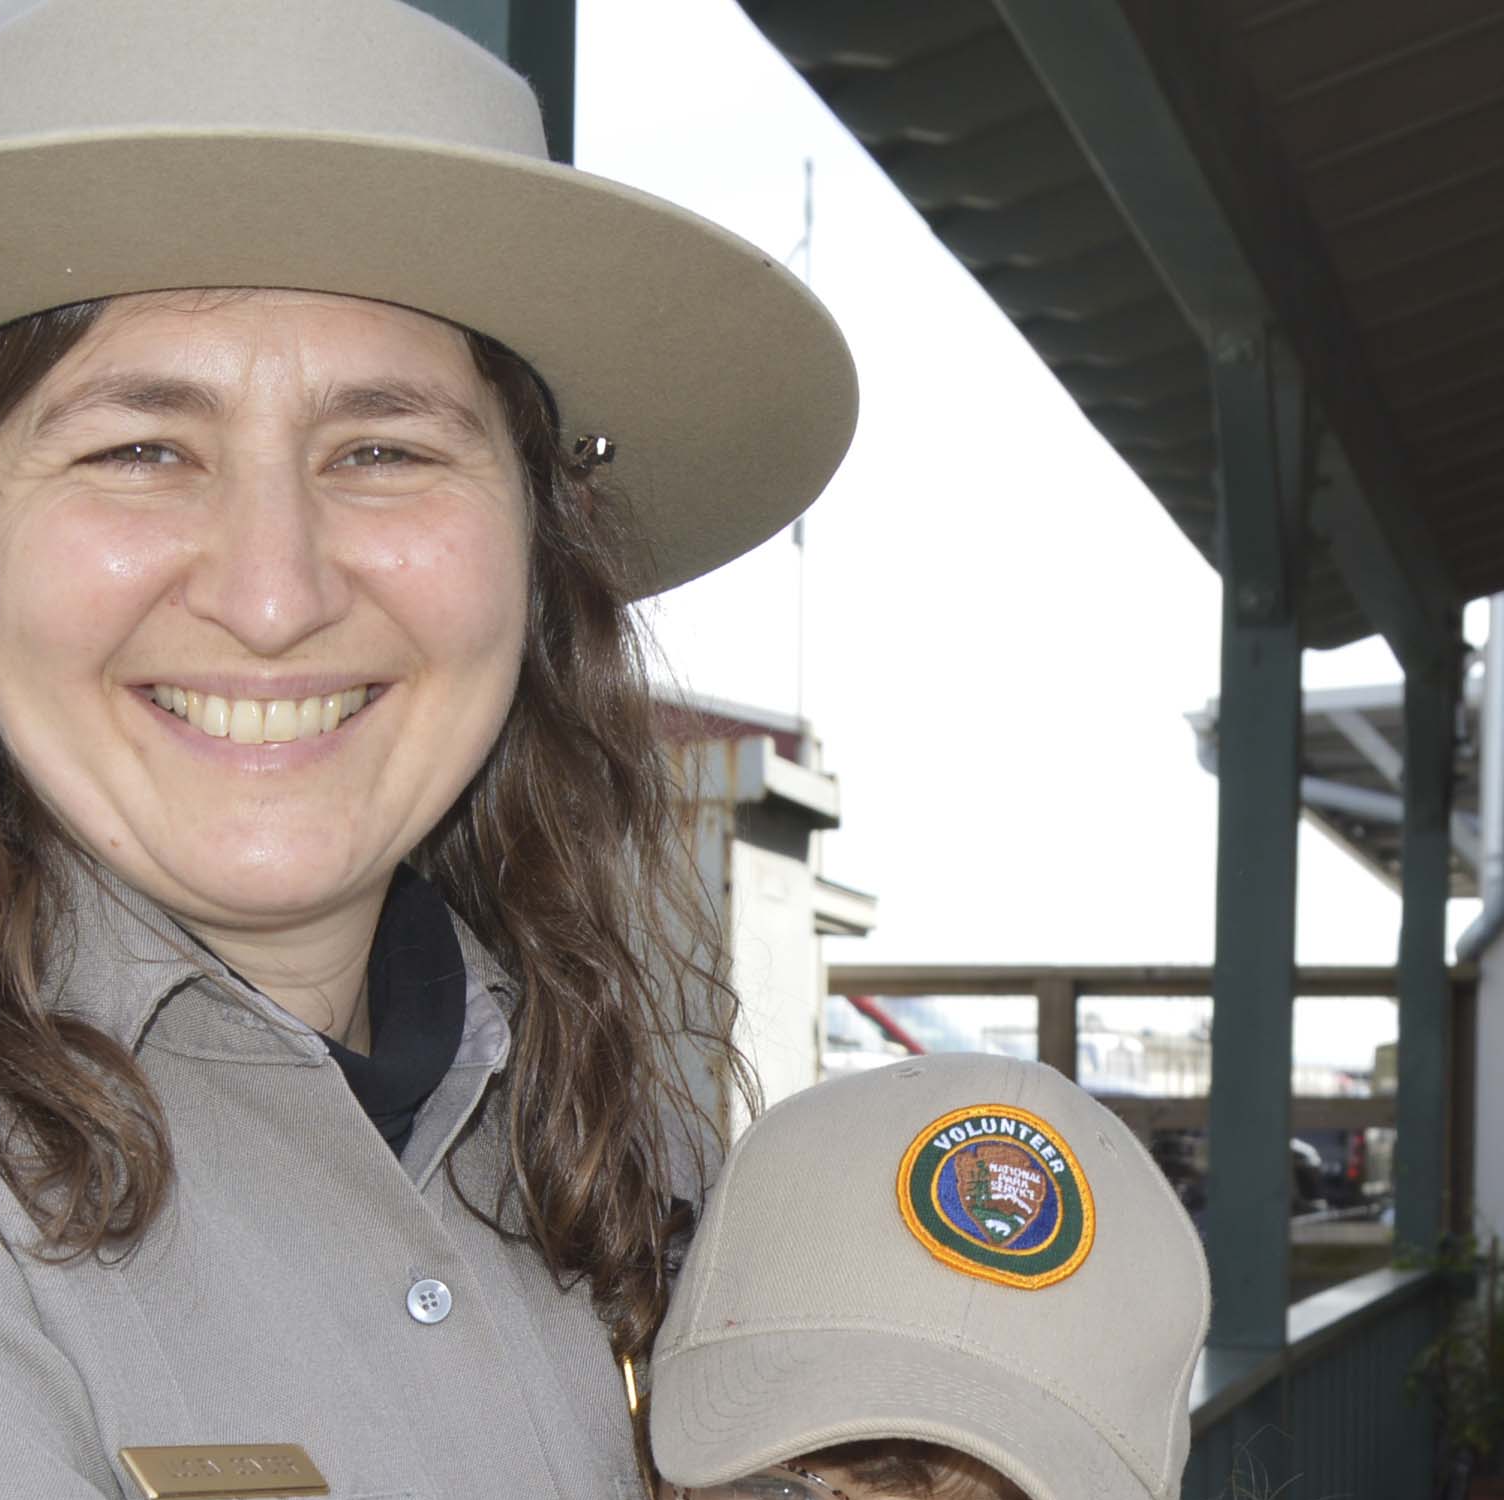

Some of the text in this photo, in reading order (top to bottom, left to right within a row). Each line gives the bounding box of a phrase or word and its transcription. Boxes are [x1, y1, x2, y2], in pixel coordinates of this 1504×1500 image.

[933, 1117, 1065, 1174] VOLUNTEER
[989, 1163, 1041, 1184] NATIONAL
[998, 1173, 1029, 1190] PARK
[991, 1180, 1035, 1201] SERVICE
